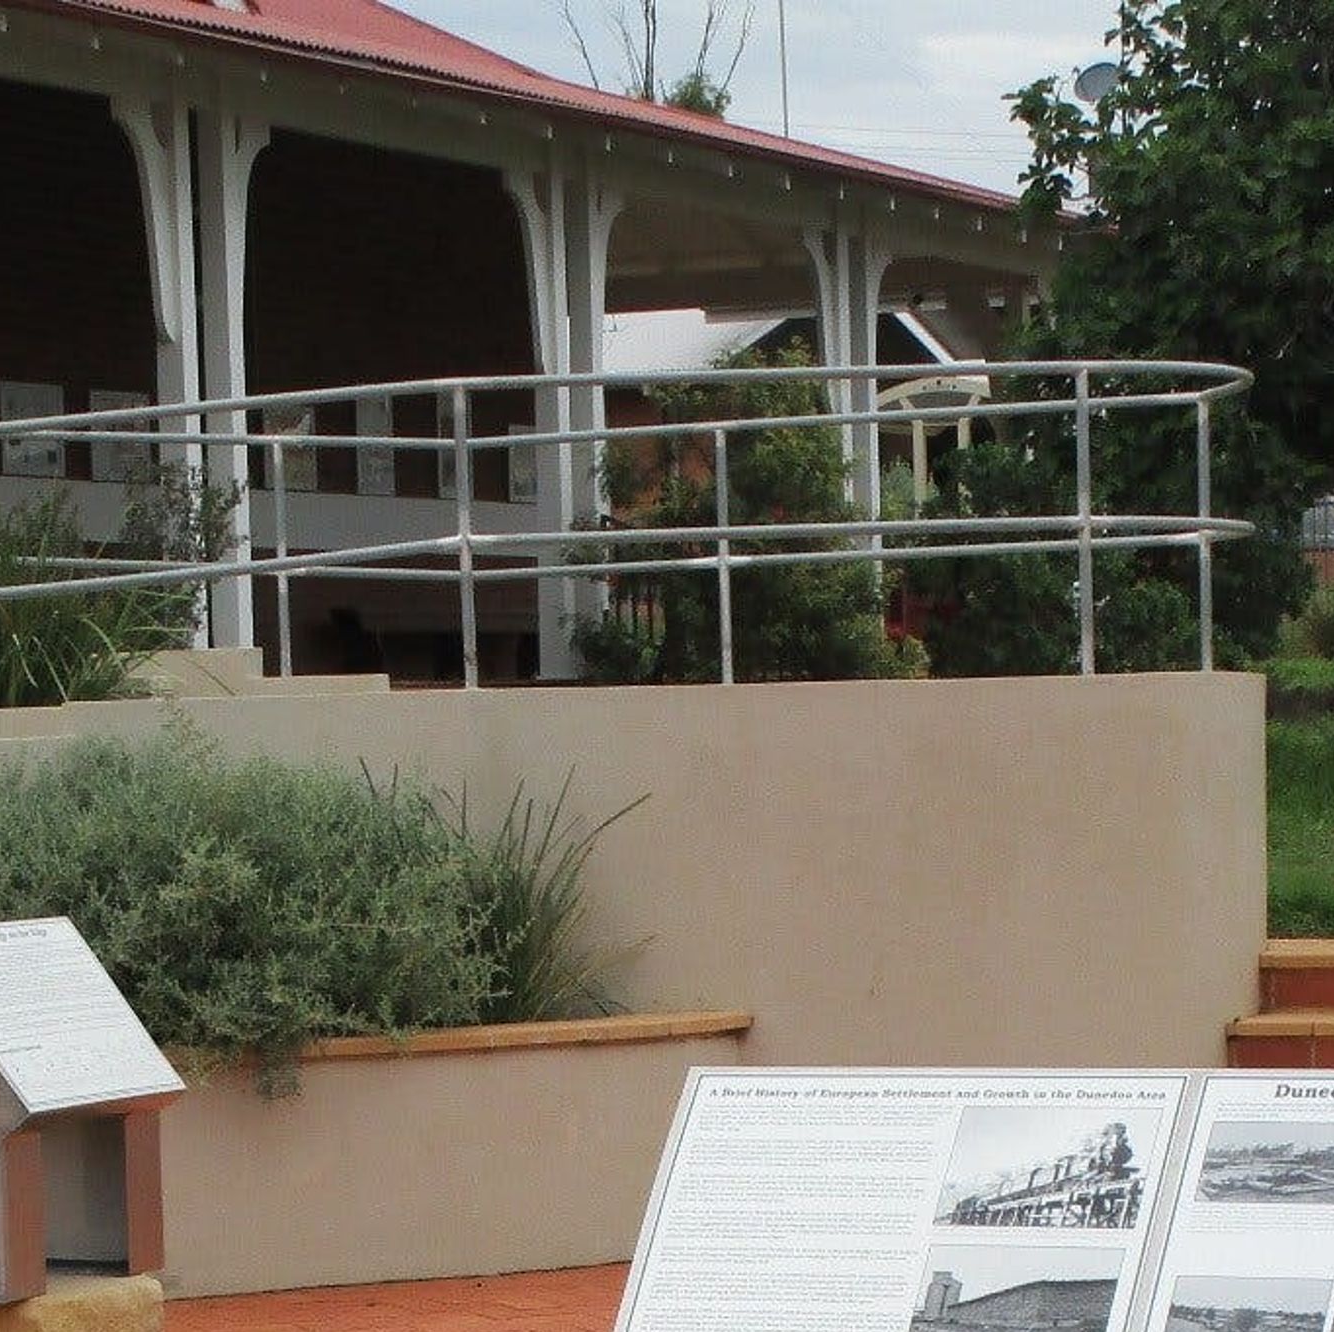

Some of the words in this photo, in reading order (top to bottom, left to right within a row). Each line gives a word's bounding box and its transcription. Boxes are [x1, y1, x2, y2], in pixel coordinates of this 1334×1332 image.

[754, 1088, 799, 1100] History
[805, 1088, 818, 1098] of
[819, 1088, 878, 1100] European
[882, 1088, 952, 1099] Settlement
[956, 1089, 981, 1098] and
[982, 1089, 1028, 1099] Growth
[1050, 1090, 1072, 1099] the
[1075, 1091, 1134, 1100] Dunedoo
[1136, 1091, 1167, 1100] Area
